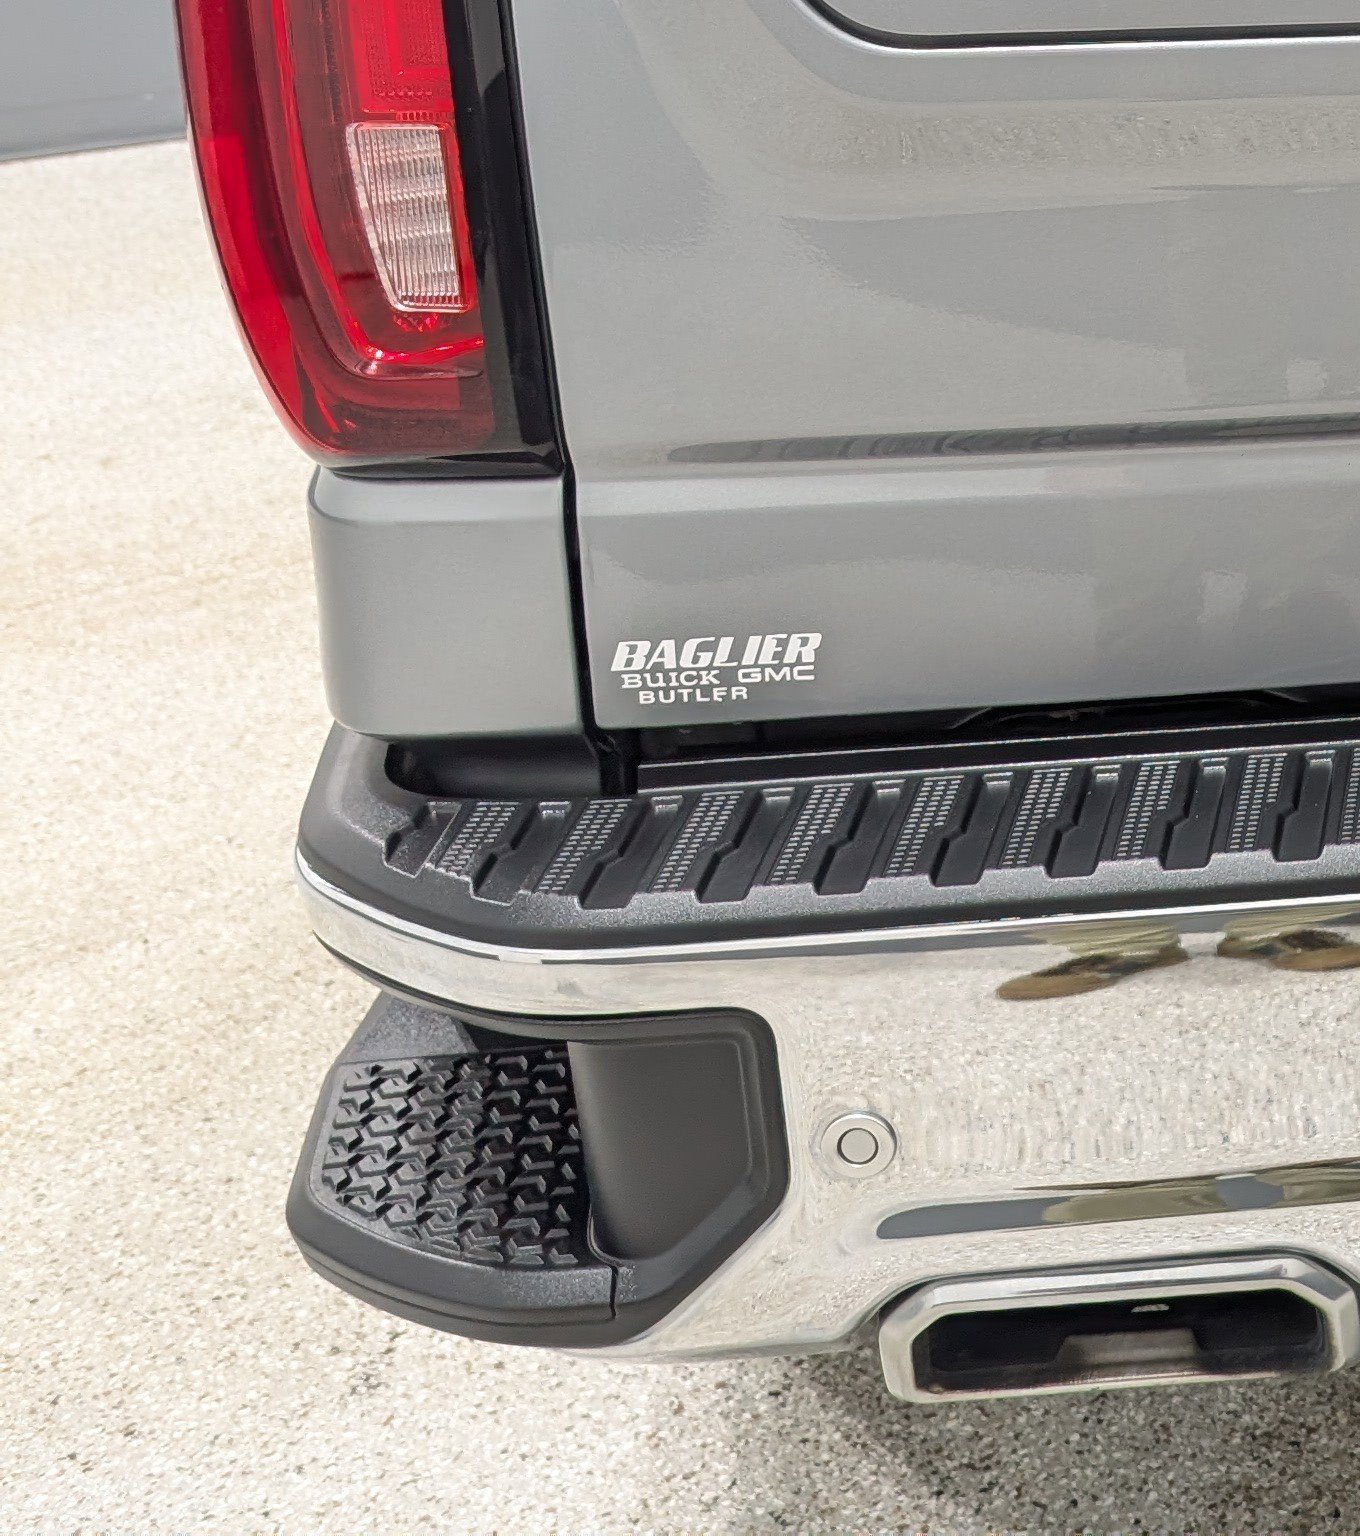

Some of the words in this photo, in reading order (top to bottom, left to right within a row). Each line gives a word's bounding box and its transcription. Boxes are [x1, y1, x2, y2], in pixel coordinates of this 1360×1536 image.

[610, 632, 822, 672] BAGLIER
[621, 669, 721, 689] BUICK
[737, 665, 816, 683] GMC
[638, 686, 749, 705] BUTLER
